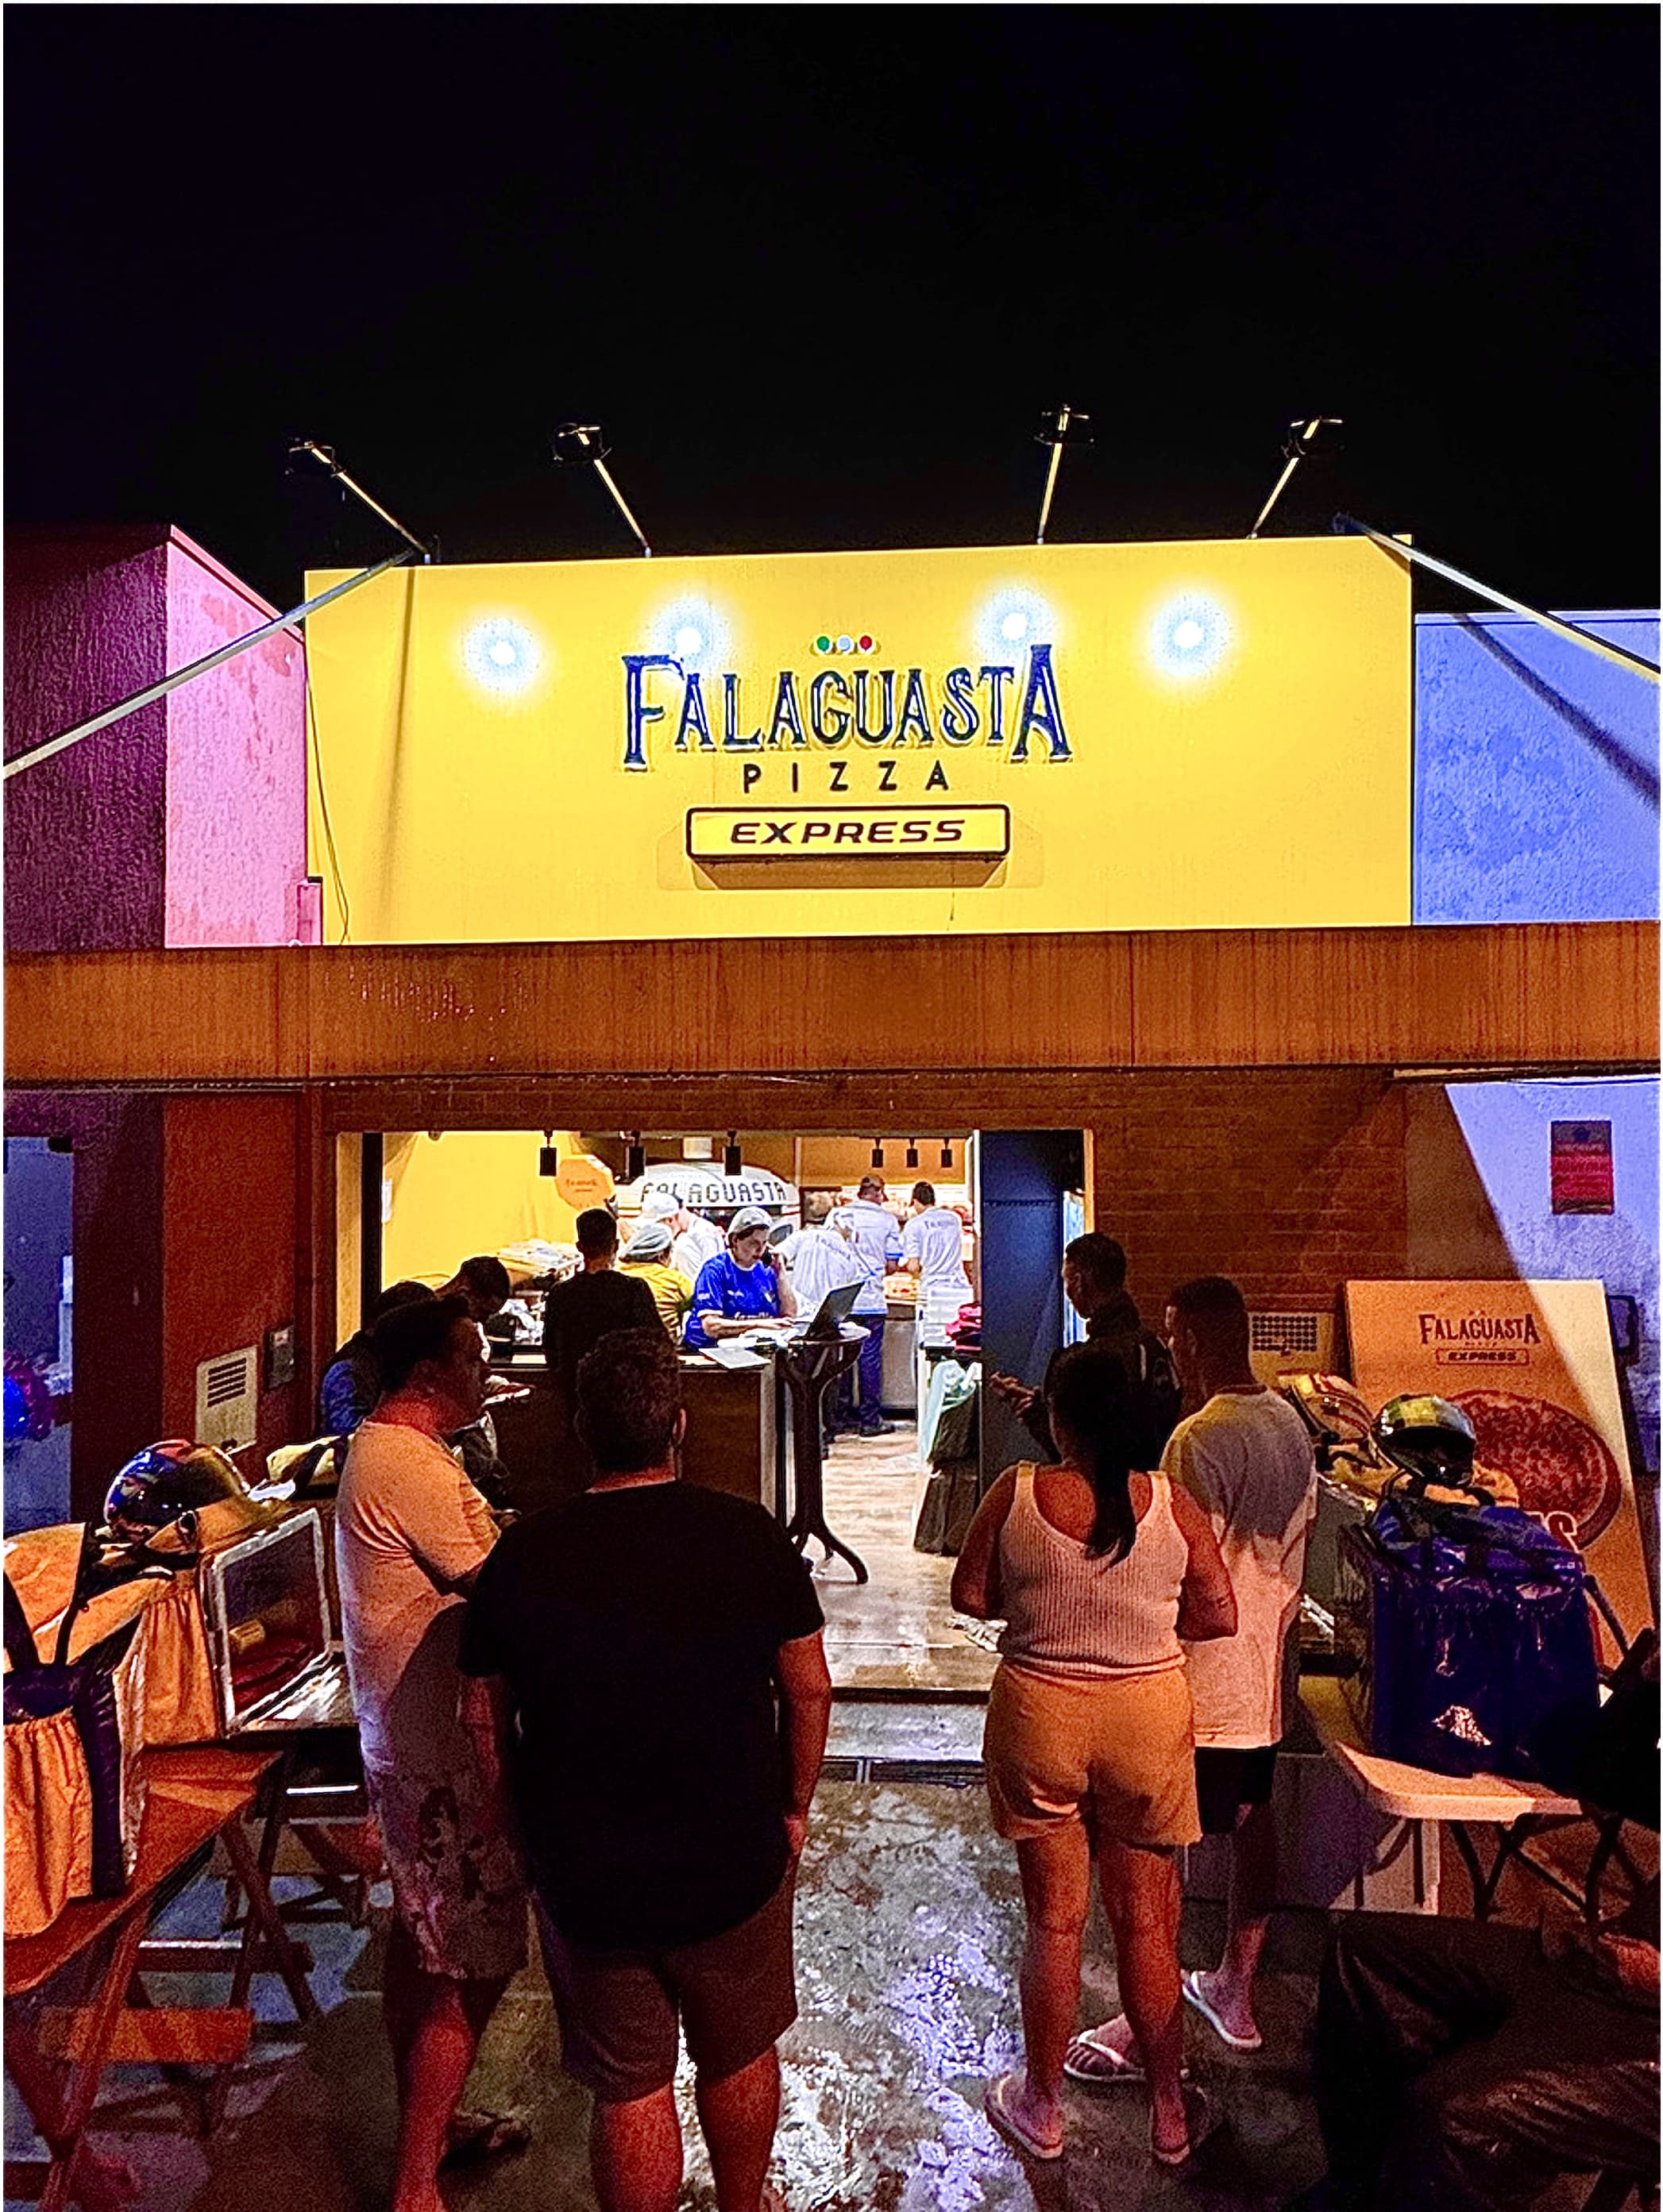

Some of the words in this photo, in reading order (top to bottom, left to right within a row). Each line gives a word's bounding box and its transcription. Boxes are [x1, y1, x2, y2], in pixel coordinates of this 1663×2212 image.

[621, 643, 1074, 772] FALAGUASTA
[743, 760, 949, 794] PIZZA
[730, 820, 966, 844] EXPRESS
[1418, 1313, 1541, 1344] FALAGUASTA
[1448, 1351, 1517, 1361] EXPRESS
